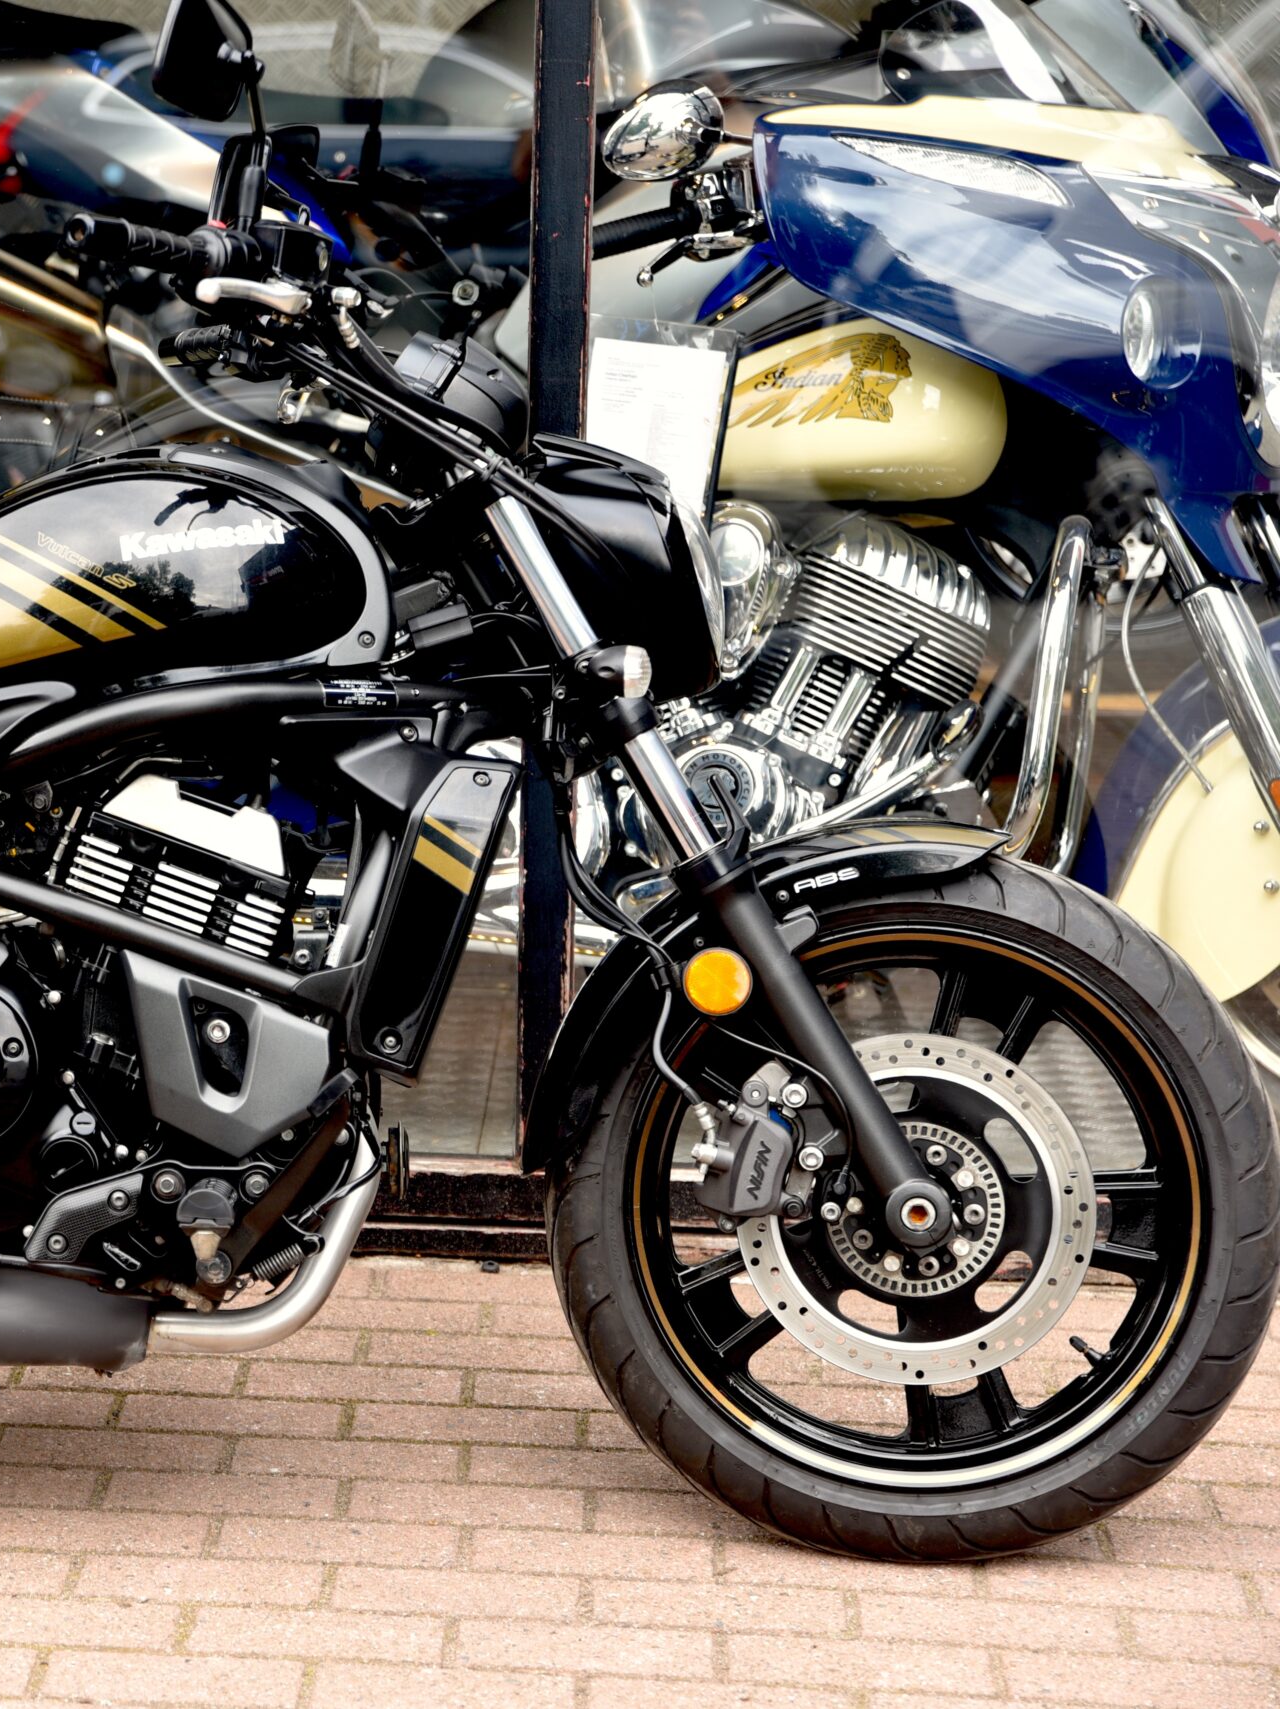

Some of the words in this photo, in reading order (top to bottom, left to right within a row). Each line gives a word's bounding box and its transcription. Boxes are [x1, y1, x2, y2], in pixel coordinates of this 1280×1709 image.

[754, 367, 842, 392] Indian
[37, 531, 104, 578] Vulcan
[120, 518, 285, 561] Kawasaki
[793, 866, 860, 894] ABS
